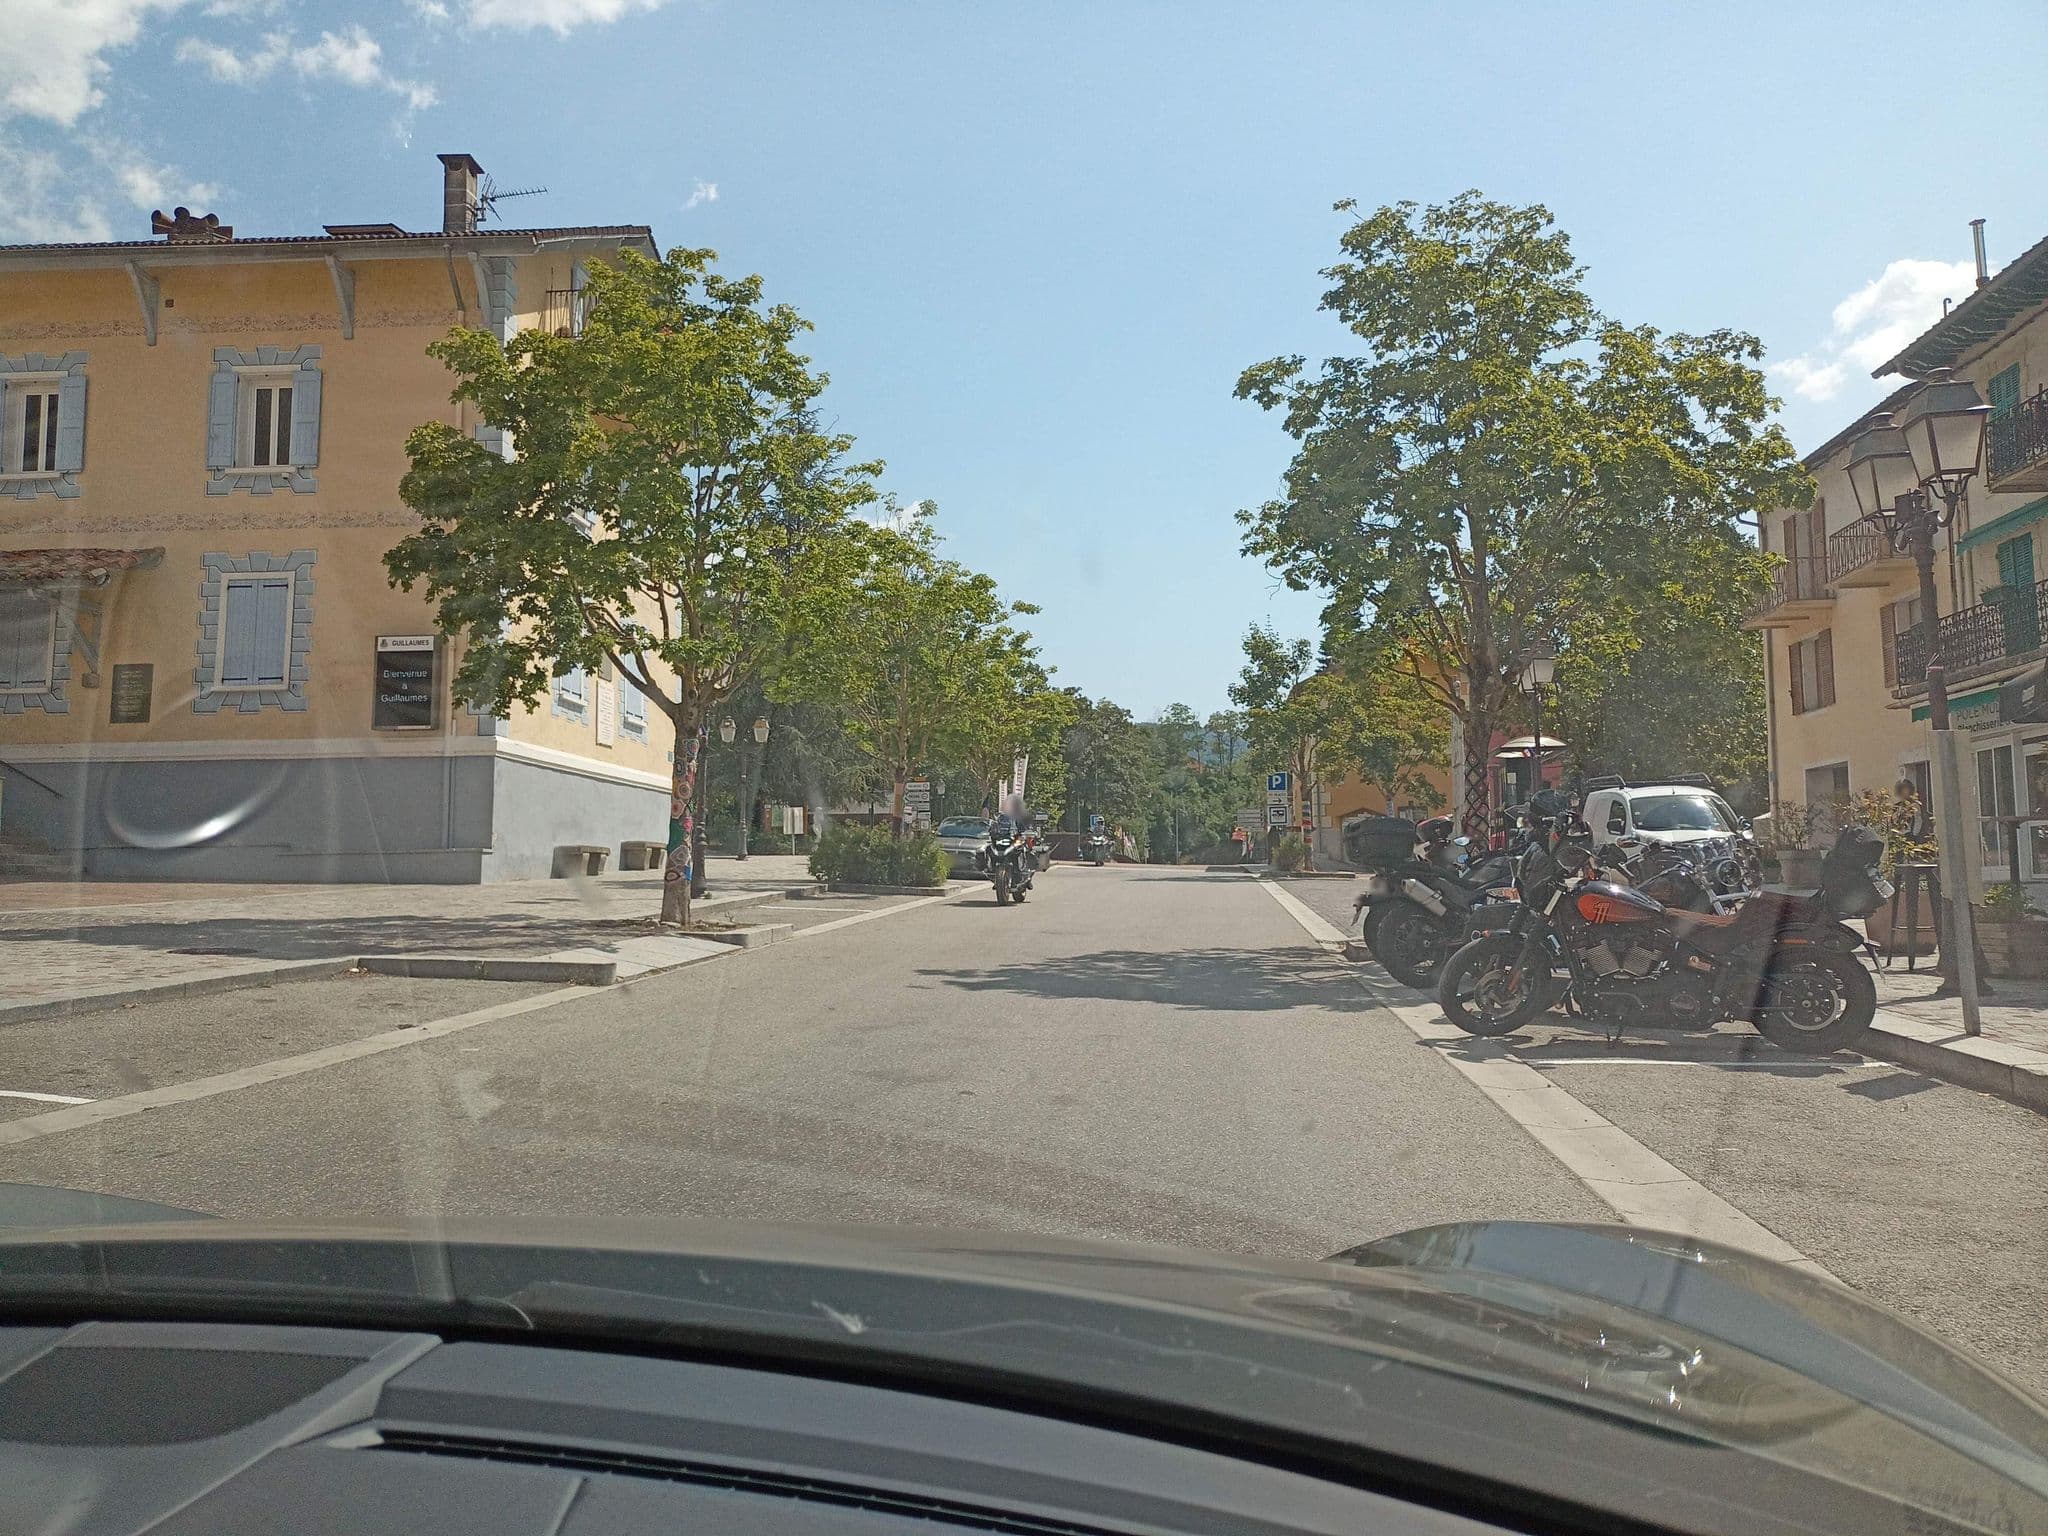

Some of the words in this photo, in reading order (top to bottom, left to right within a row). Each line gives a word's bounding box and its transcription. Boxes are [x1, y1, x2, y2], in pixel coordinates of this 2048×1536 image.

[383, 670, 428, 678] Bienvenue
[381, 694, 428, 703] Guillaumes
[1272, 775, 1282, 788] P
